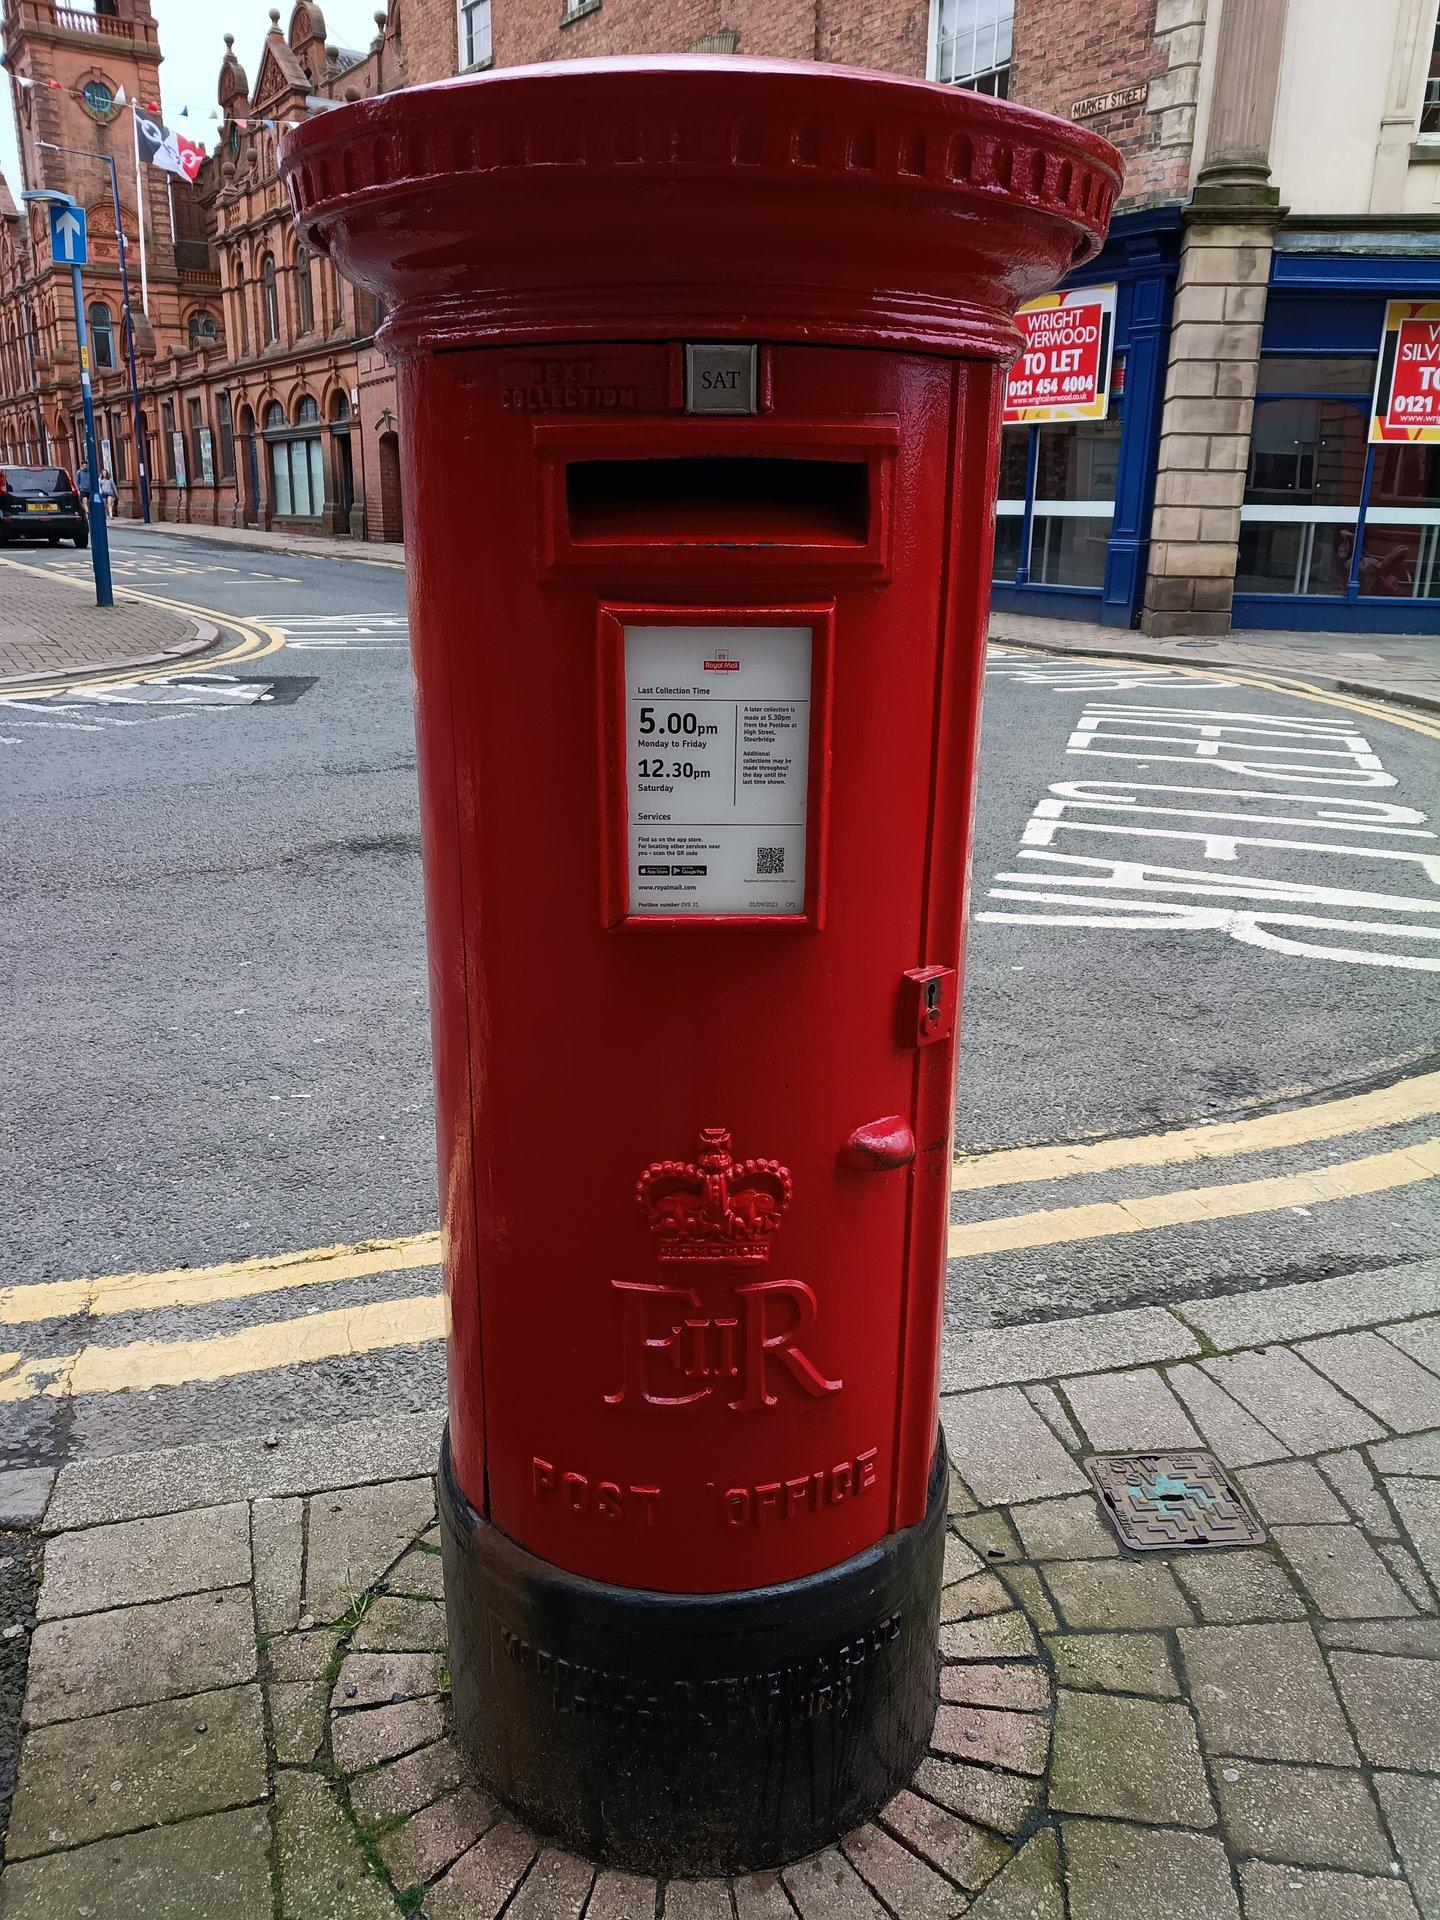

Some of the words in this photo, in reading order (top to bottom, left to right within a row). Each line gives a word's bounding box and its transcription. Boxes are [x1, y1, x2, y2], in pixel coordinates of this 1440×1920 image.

[1073, 96, 1109, 118] MARKET
[1111, 85, 1146, 107] STREET
[1028, 309, 1084, 331] WRIGHT
[1023, 325, 1098, 349] VERWOOD
[1023, 352, 1046, 375] TO
[1050, 348, 1083, 373] LET
[1402, 343, 1440, 361] SILV
[701, 370, 741, 390] SAT
[1009, 379, 1033, 397] 0121
[1036, 377, 1058, 394] 454
[1062, 374, 1093, 392] 4004
[500, 387, 634, 408] COLLECTION
[1394, 395, 1433, 413] 0121
[640, 707, 718, 736] 5.00pm
[637, 740, 669, 749] Monday
[671, 740, 680, 748] to
[682, 740, 707, 749] Friday
[637, 759, 711, 780] 12.30pm
[637, 784, 674, 793] Saturday
[637, 812, 671, 821] Services
[533, 1457, 661, 1527] POST
[725, 1446, 877, 1527] OFFICE
